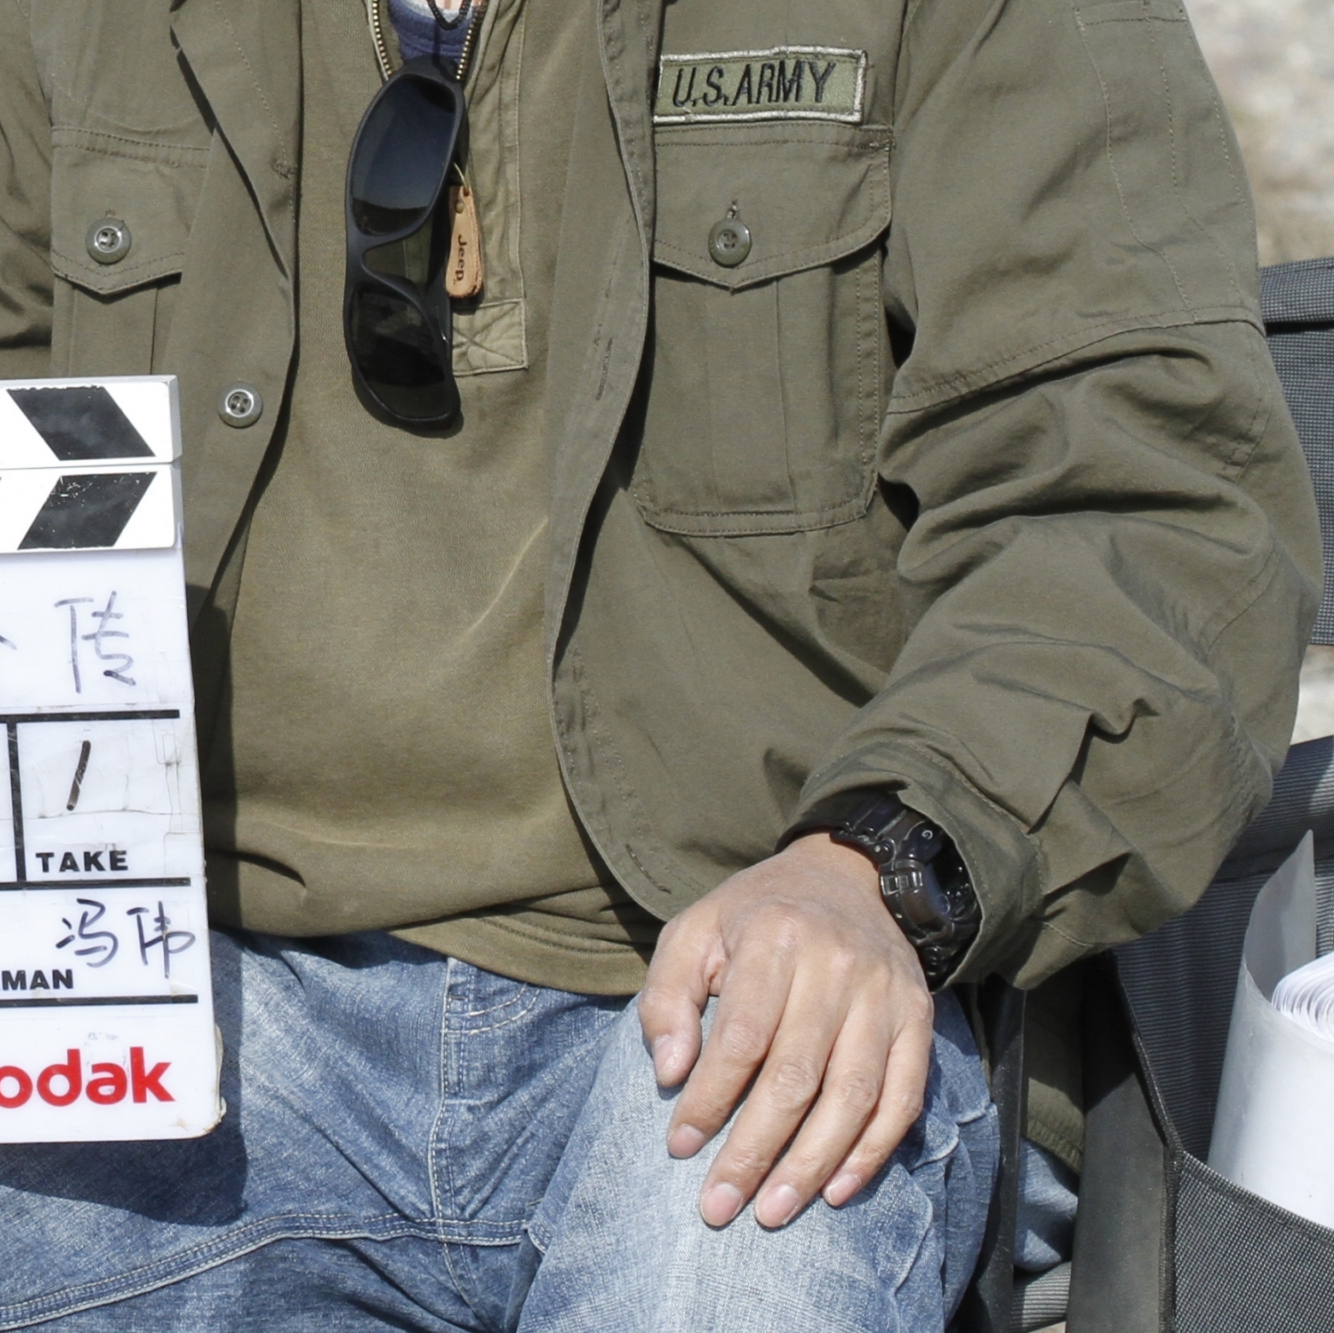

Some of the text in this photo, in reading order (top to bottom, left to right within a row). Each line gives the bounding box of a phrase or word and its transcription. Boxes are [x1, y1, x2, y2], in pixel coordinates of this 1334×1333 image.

[455, 234, 467, 282] Jeep
[67, 740, 91, 811] 1
[35, 850, 128, 872] TAKE
